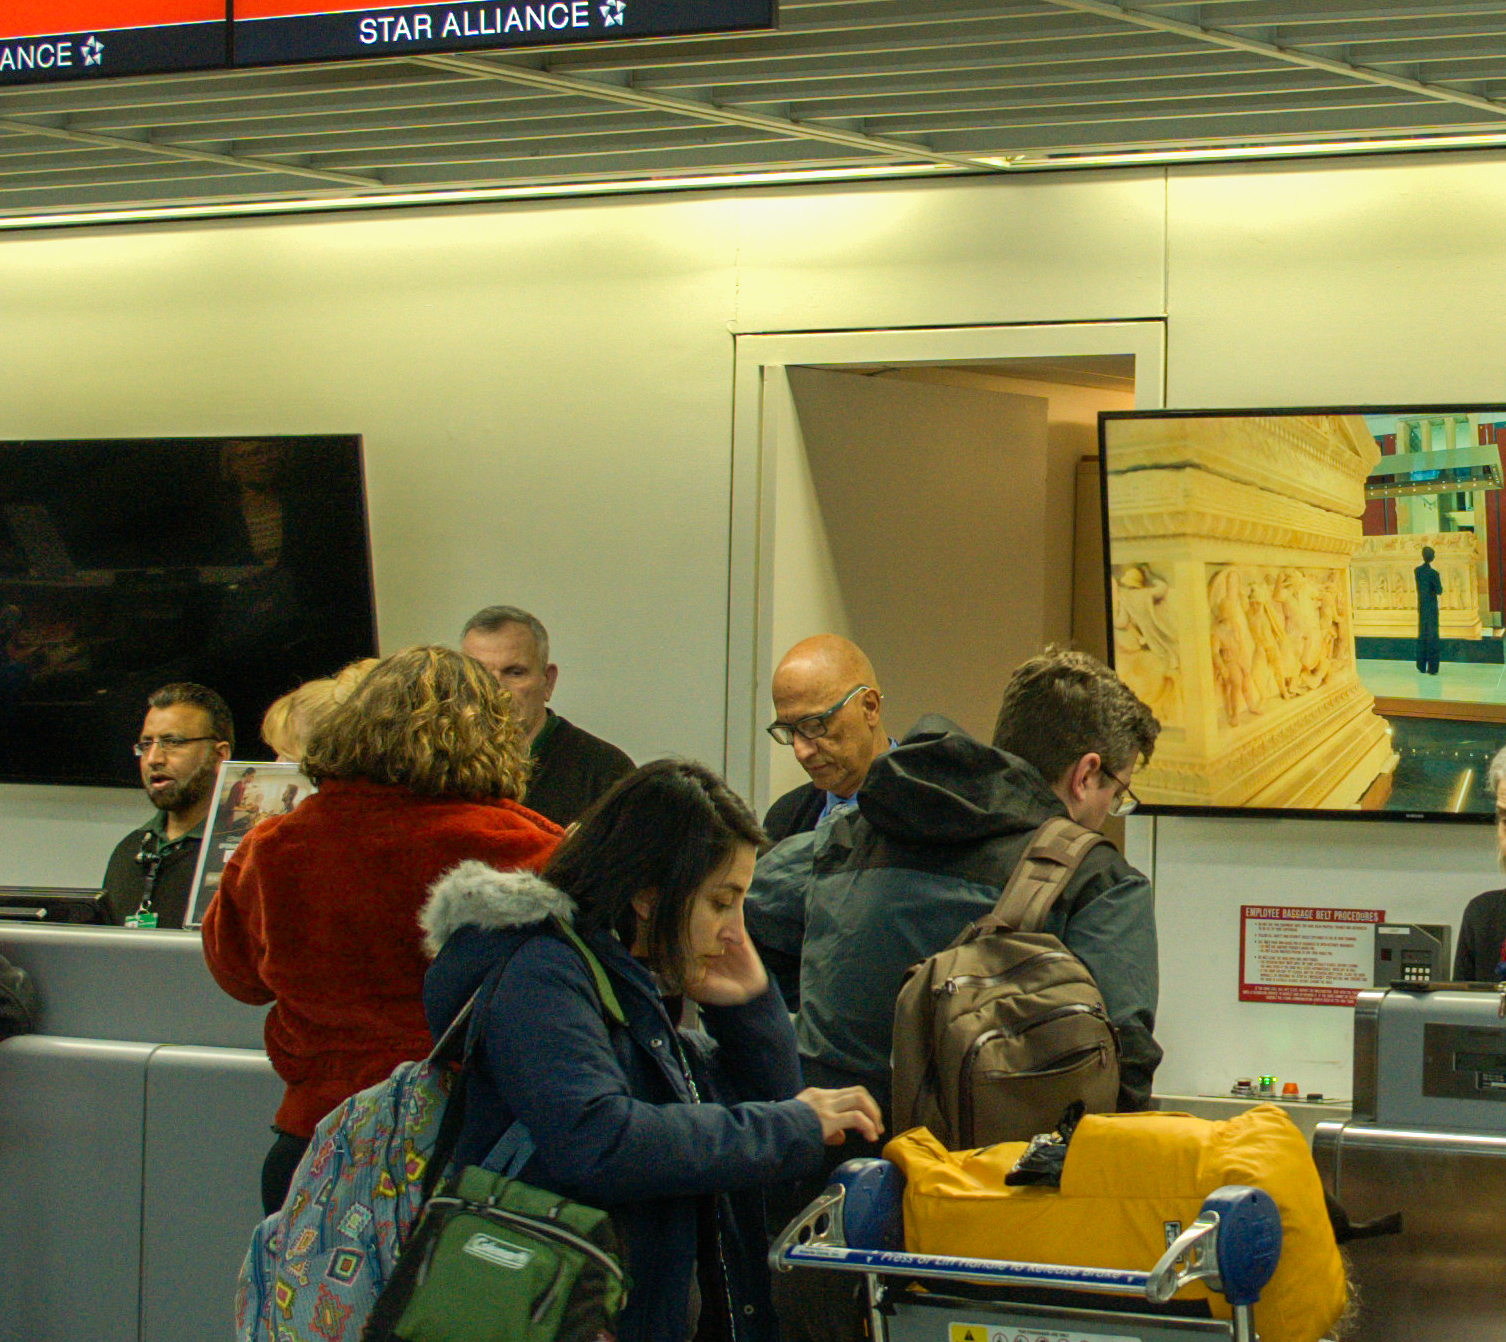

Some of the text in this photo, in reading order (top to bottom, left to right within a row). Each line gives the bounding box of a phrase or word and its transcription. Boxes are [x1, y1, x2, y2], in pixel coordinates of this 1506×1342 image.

[358, 0, 590, 45] STAR ALLIANCE
[1246, 908, 1280, 918] EMPLOYEE
[1316, 910, 1332, 920] BELT
[1334, 910, 1378, 921] PROCEDURES
